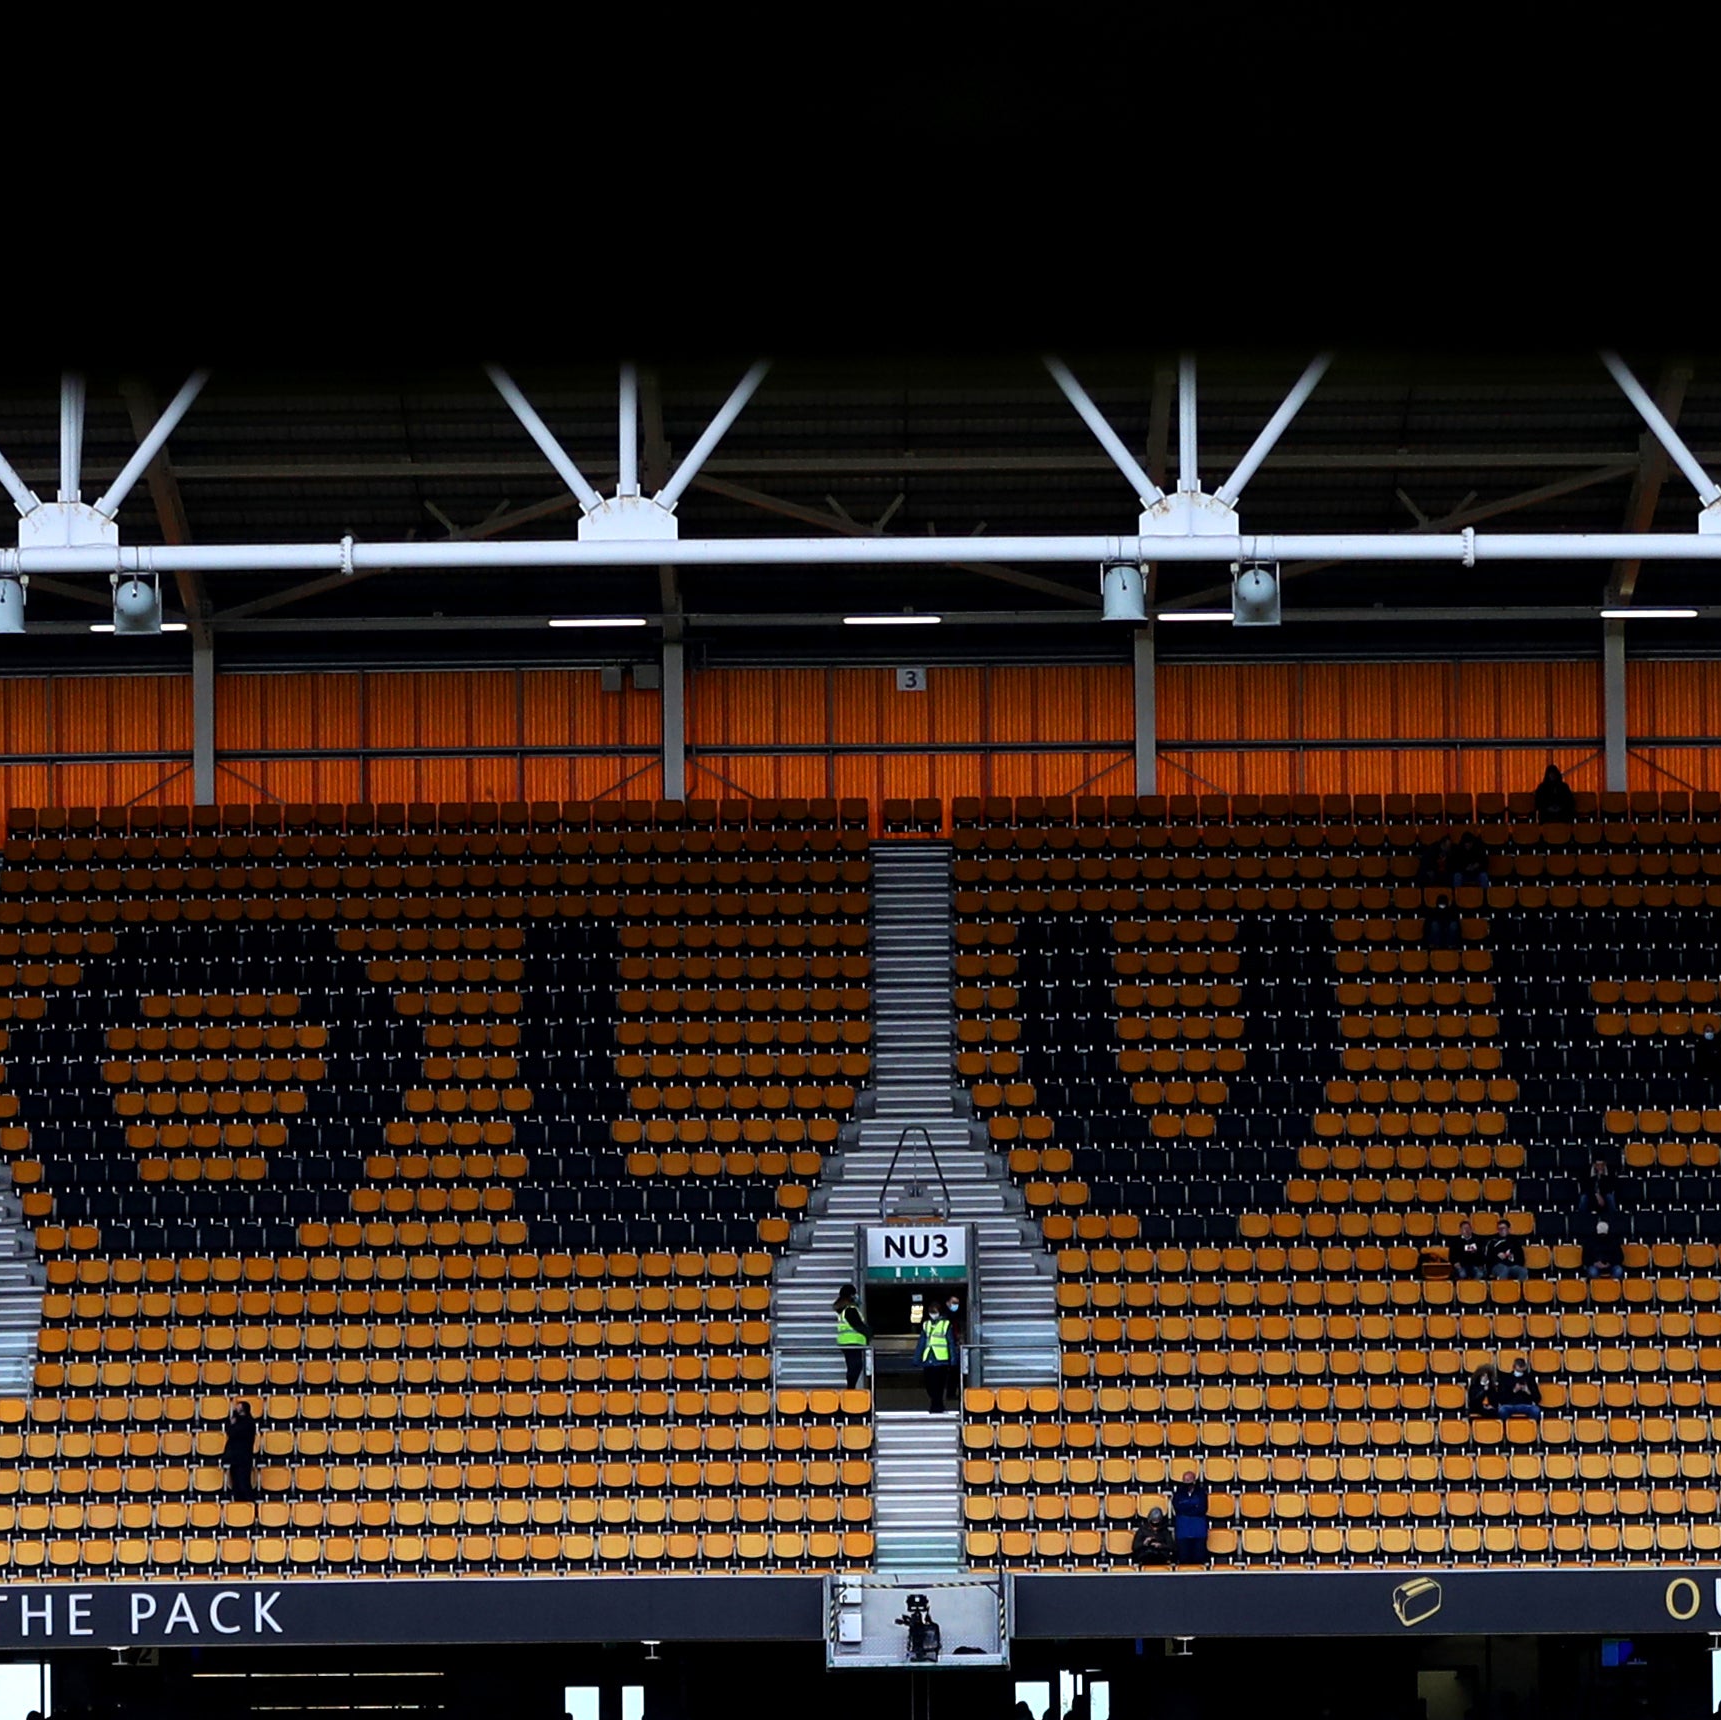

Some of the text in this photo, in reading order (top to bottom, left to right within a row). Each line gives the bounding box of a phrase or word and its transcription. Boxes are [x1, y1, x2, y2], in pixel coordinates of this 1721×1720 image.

[905, 670, 917, 688] 3
[884, 1234, 949, 1259] NU3
[131, 1591, 284, 1635] PACK
